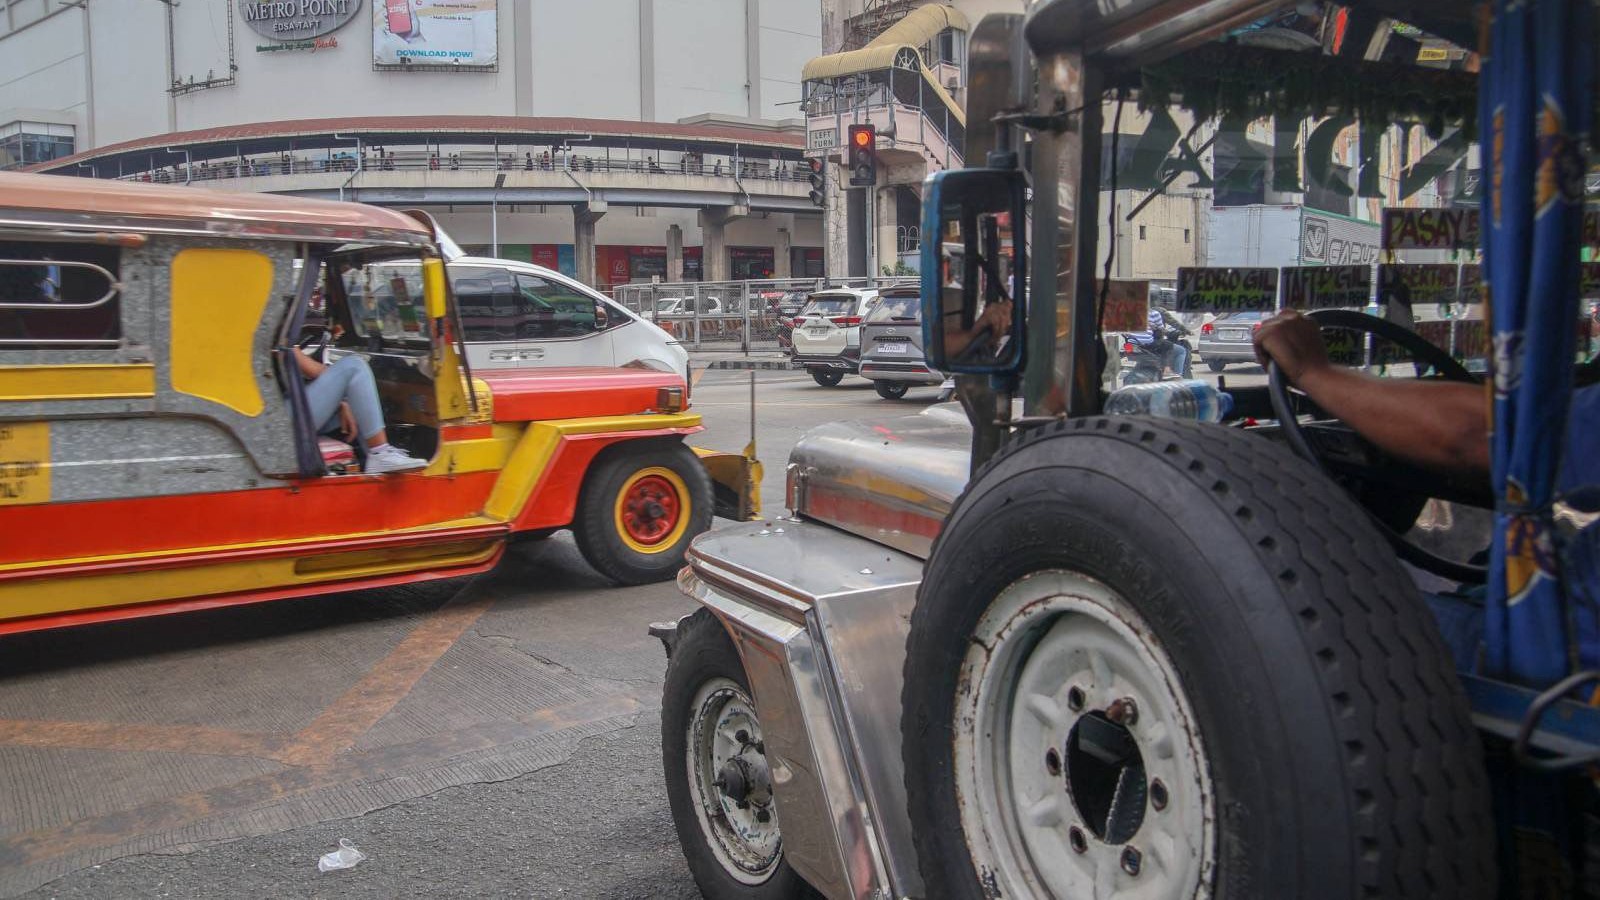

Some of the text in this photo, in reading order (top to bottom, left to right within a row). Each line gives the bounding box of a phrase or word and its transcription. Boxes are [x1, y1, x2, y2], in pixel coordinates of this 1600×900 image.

[247, 0, 349, 21] METRO POINT
[396, 49, 473, 58] DOWNLOAD NOW!
[814, 130, 831, 139] LEFT
[814, 139, 833, 149] TURN
[1383, 209, 1464, 247] PASAY
[1181, 268, 1274, 290] PEDRO GIL
